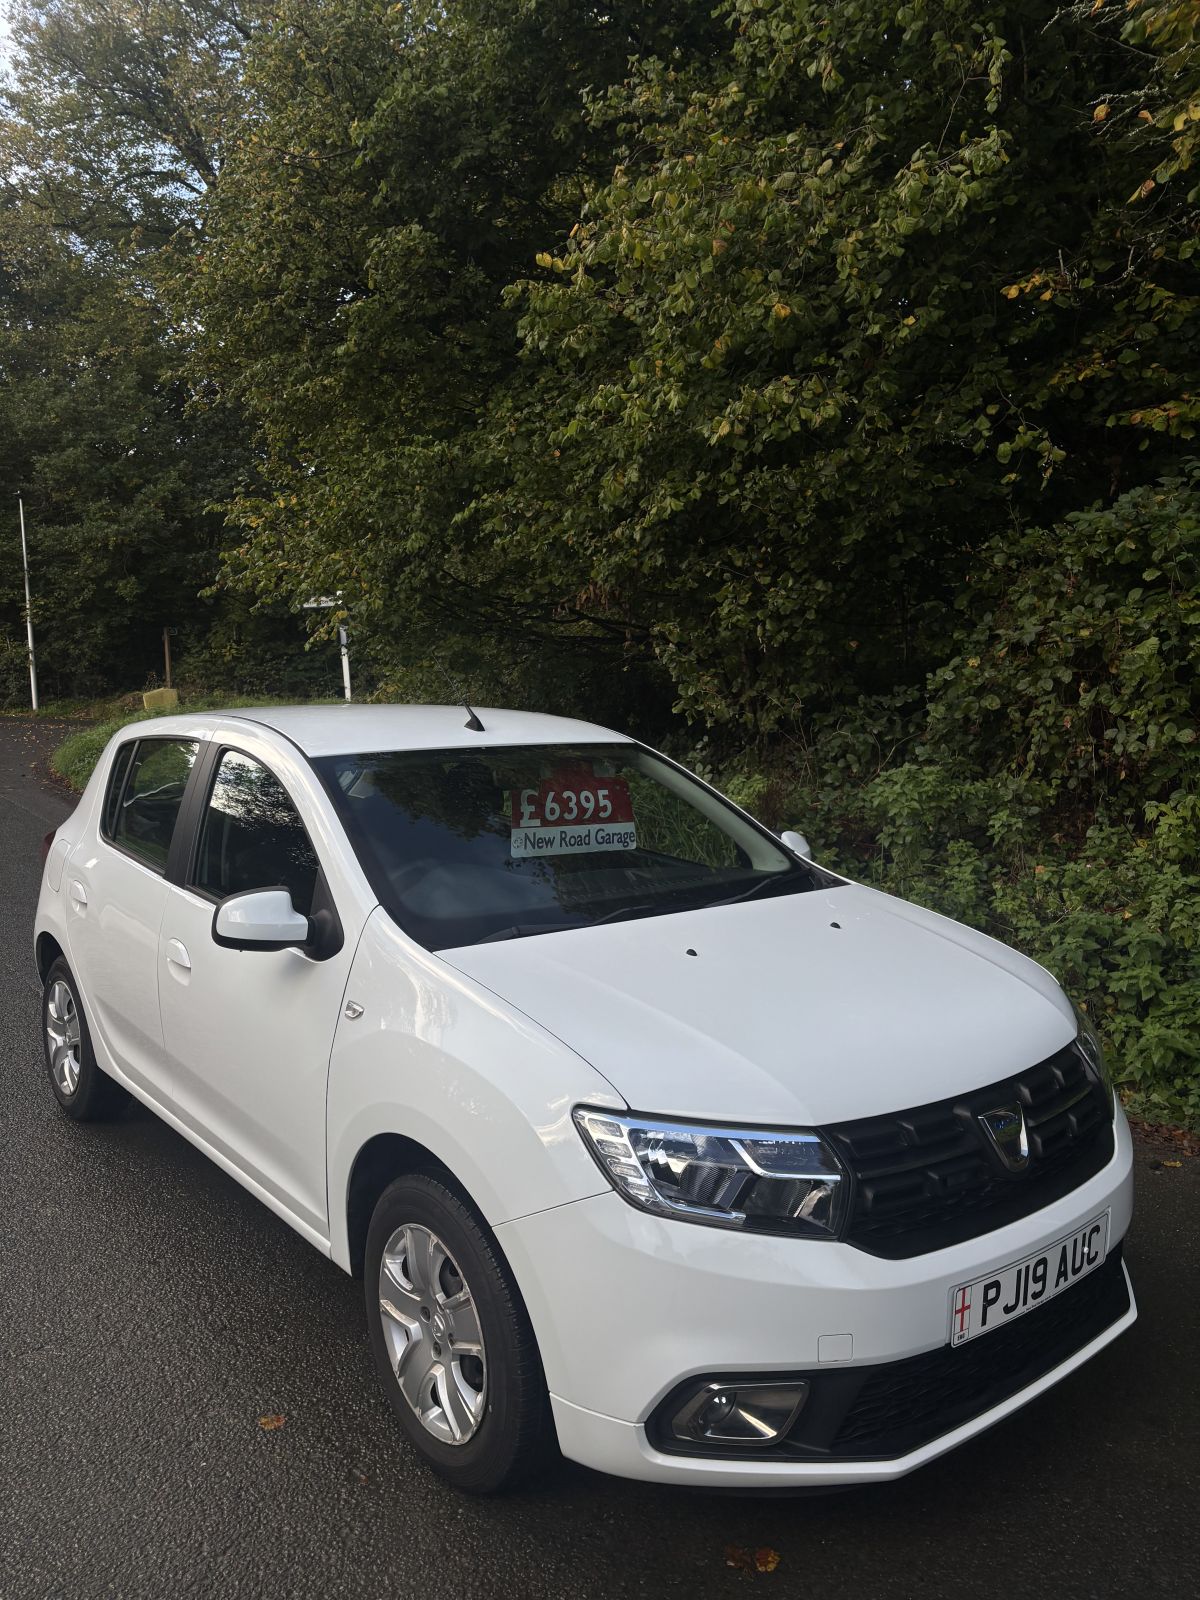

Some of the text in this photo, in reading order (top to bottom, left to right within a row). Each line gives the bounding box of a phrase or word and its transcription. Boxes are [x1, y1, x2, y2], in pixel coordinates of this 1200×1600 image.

[524, 828, 635, 850] New Road Garage
[980, 1224, 1101, 1328] PJ19 AUC
